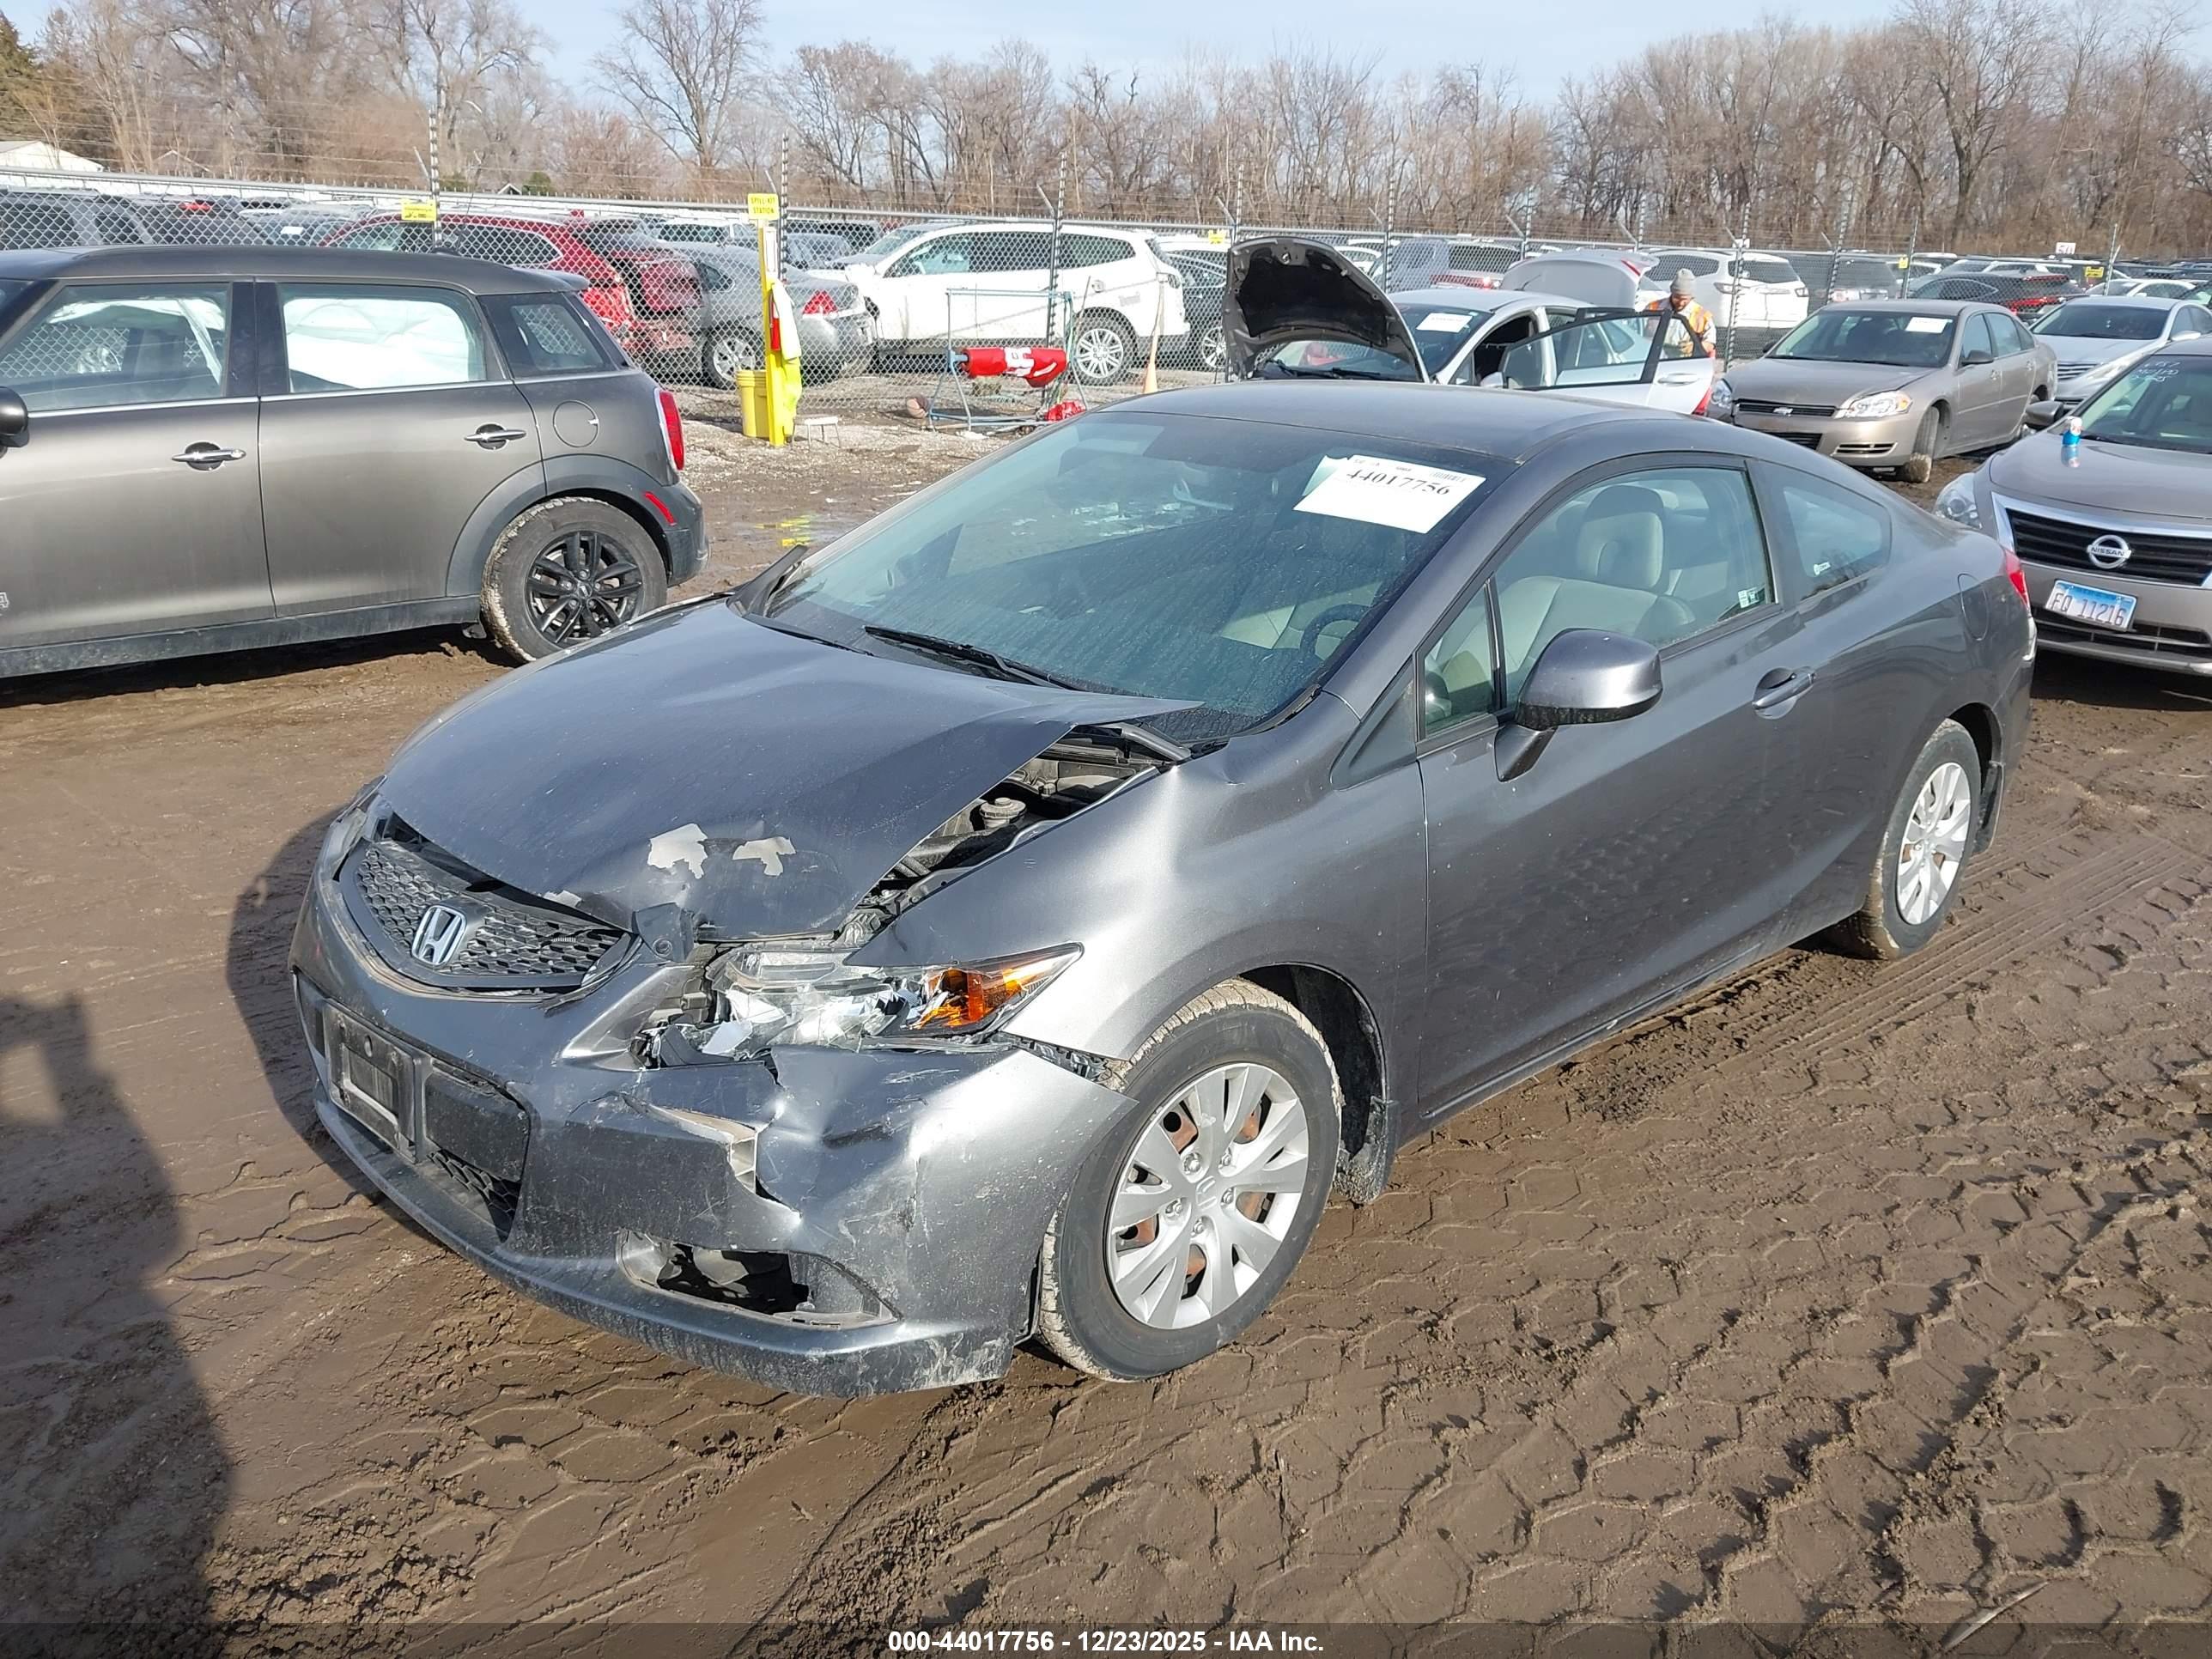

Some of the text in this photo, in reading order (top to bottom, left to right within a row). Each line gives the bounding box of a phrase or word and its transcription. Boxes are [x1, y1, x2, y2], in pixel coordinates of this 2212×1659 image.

[1346, 469, 1450, 495] 44017756
[2091, 546, 2124, 556] NISSAN
[2078, 599, 2127, 627] 11216
